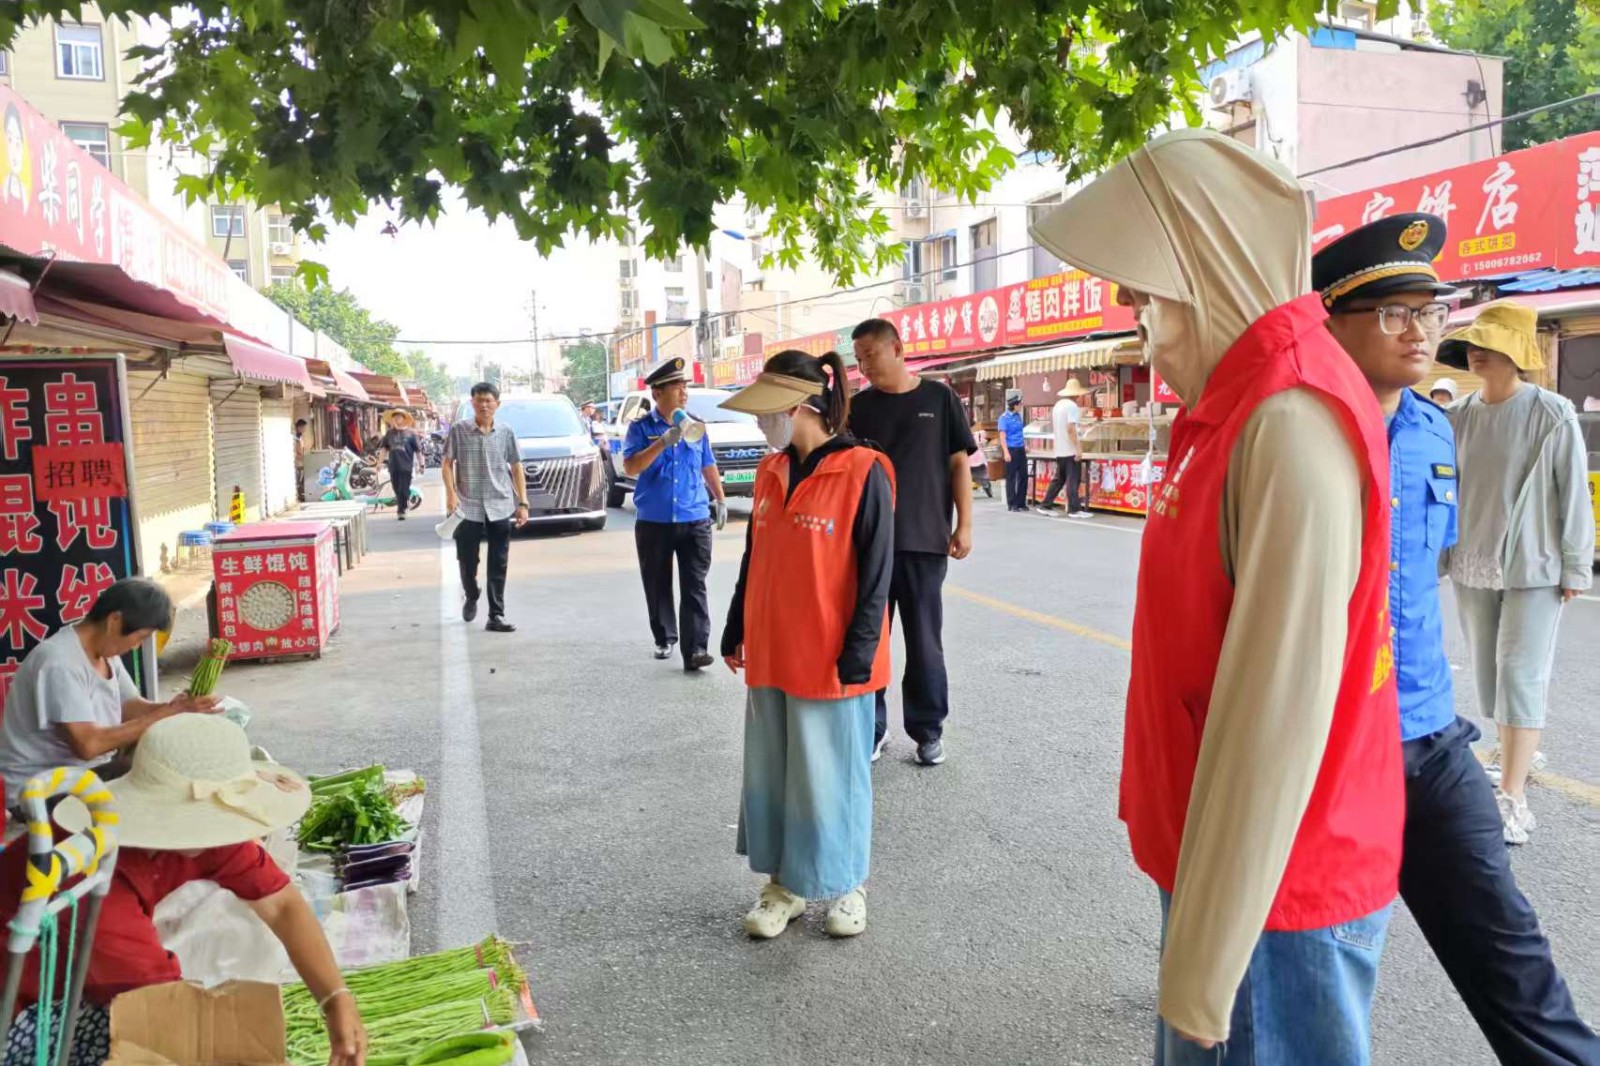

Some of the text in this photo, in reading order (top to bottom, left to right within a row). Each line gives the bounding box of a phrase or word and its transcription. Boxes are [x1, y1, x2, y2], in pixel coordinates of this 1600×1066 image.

[1025, 277, 1102, 323] 烤肉拌饭
[724, 448, 759, 459] JAC
[44, 458, 115, 489] 招聘
[1088, 460, 1149, 487] 各炒菜
[220, 552, 309, 577] 生鲜馄饨
